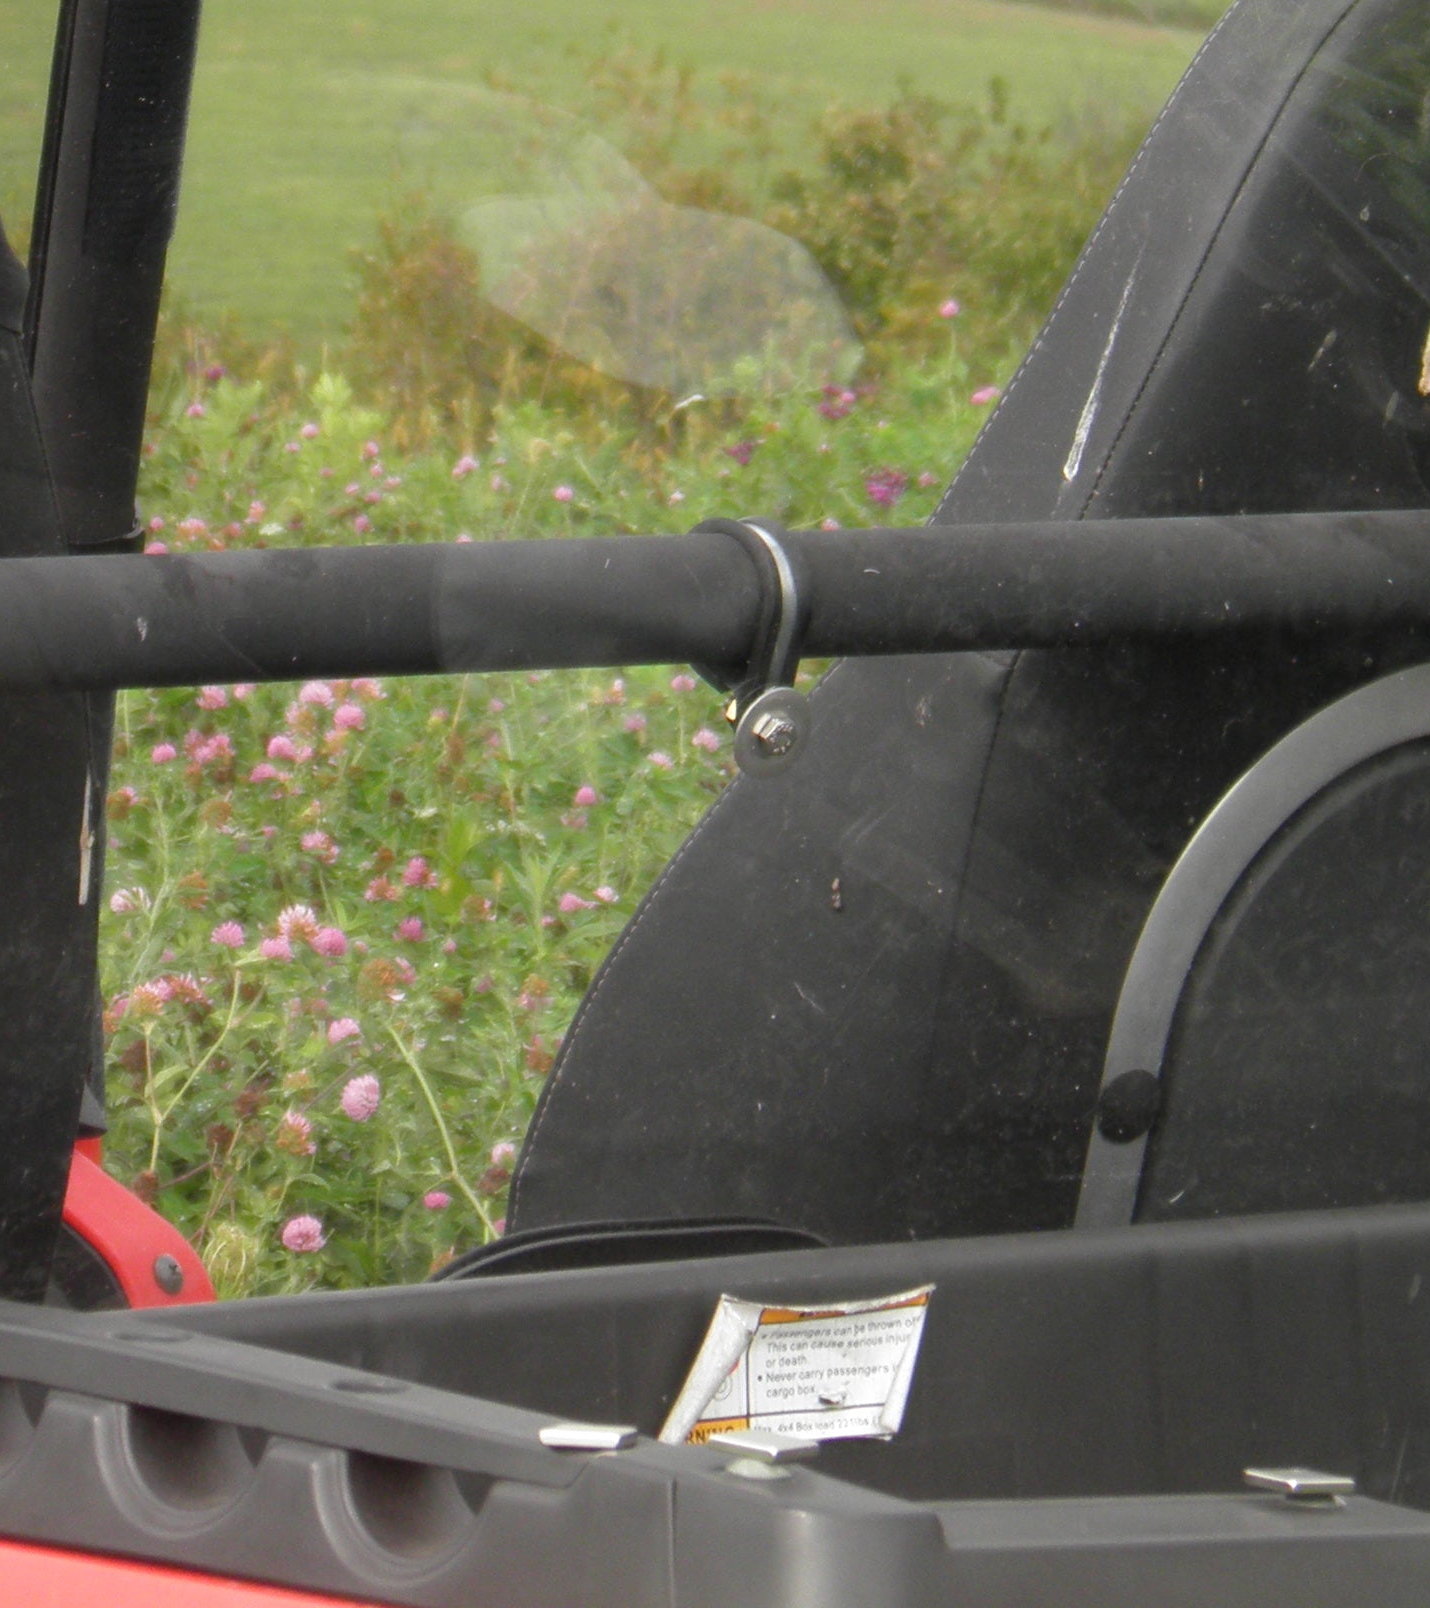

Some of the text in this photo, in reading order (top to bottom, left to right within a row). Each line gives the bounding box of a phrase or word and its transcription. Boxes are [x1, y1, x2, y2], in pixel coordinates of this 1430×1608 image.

[833, 1326, 852, 1337] can
[867, 1319, 902, 1332] thrown
[767, 1342, 787, 1353] This
[789, 1341, 808, 1352] can
[810, 1339, 845, 1350] cause
[846, 1335, 883, 1348] serious
[765, 1358, 776, 1368] or
[766, 1371, 796, 1383] Never
[798, 1368, 824, 1381] carry
[827, 1364, 889, 1378] passengers
[766, 1386, 795, 1399] cargo
[777, 1423, 793, 1433] 4x4
[796, 1421, 813, 1432] Box
[815, 1420, 835, 1431] load
